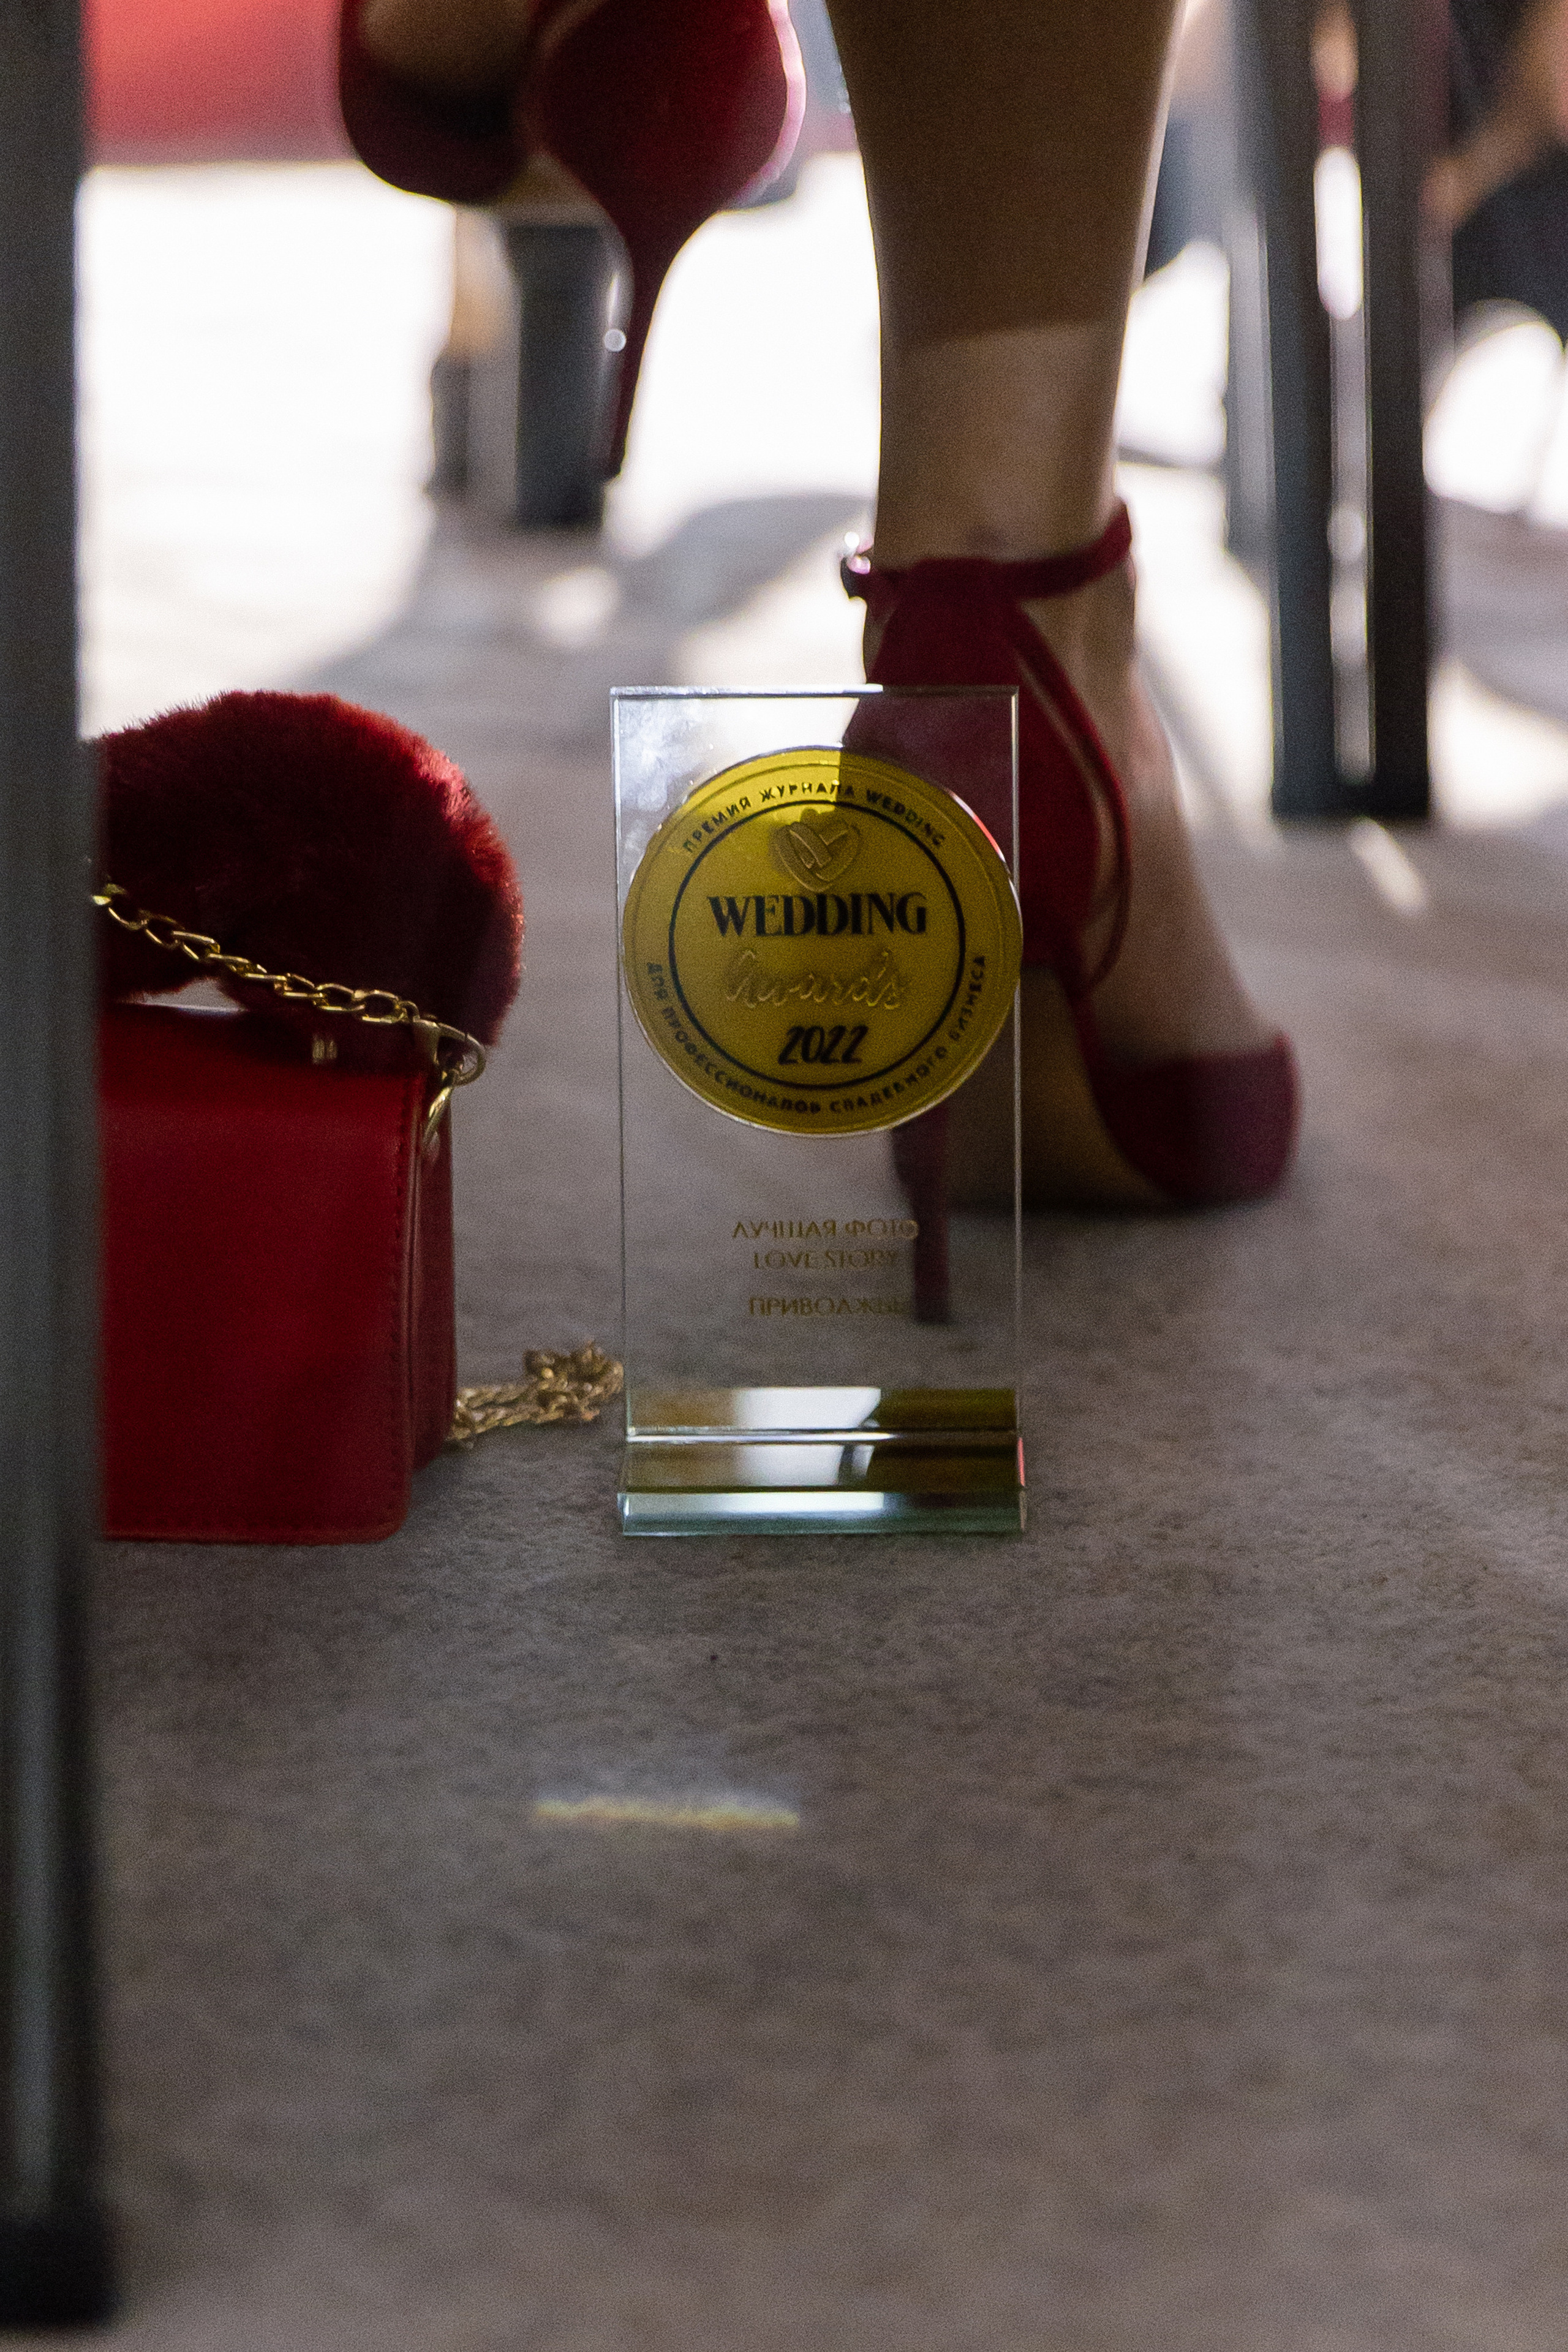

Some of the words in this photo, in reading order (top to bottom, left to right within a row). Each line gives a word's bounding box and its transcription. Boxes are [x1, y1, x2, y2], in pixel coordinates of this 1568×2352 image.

[683, 797, 751, 853] ПРЕМИЯ
[761, 782, 854, 802] ЖУРНАЛА
[866, 789, 946, 849] WEDDING
[707, 892, 927, 937] WEDDING
[647, 962, 668, 999] ДЛЯ
[662, 1007, 821, 1114] ПРОФЕССИОНАЛОВ
[829, 1046, 948, 1112] СВАДЕБНОГО
[949, 954, 986, 1042] БИЗНЕСА
[778, 1024, 869, 1065] 2022
[732, 1219, 837, 1239] ЛУЧШАЯ
[844, 1218, 919, 1240] ФОТО
[753, 1250, 818, 1270] LOVE
[824, 1250, 898, 1270] STORY
